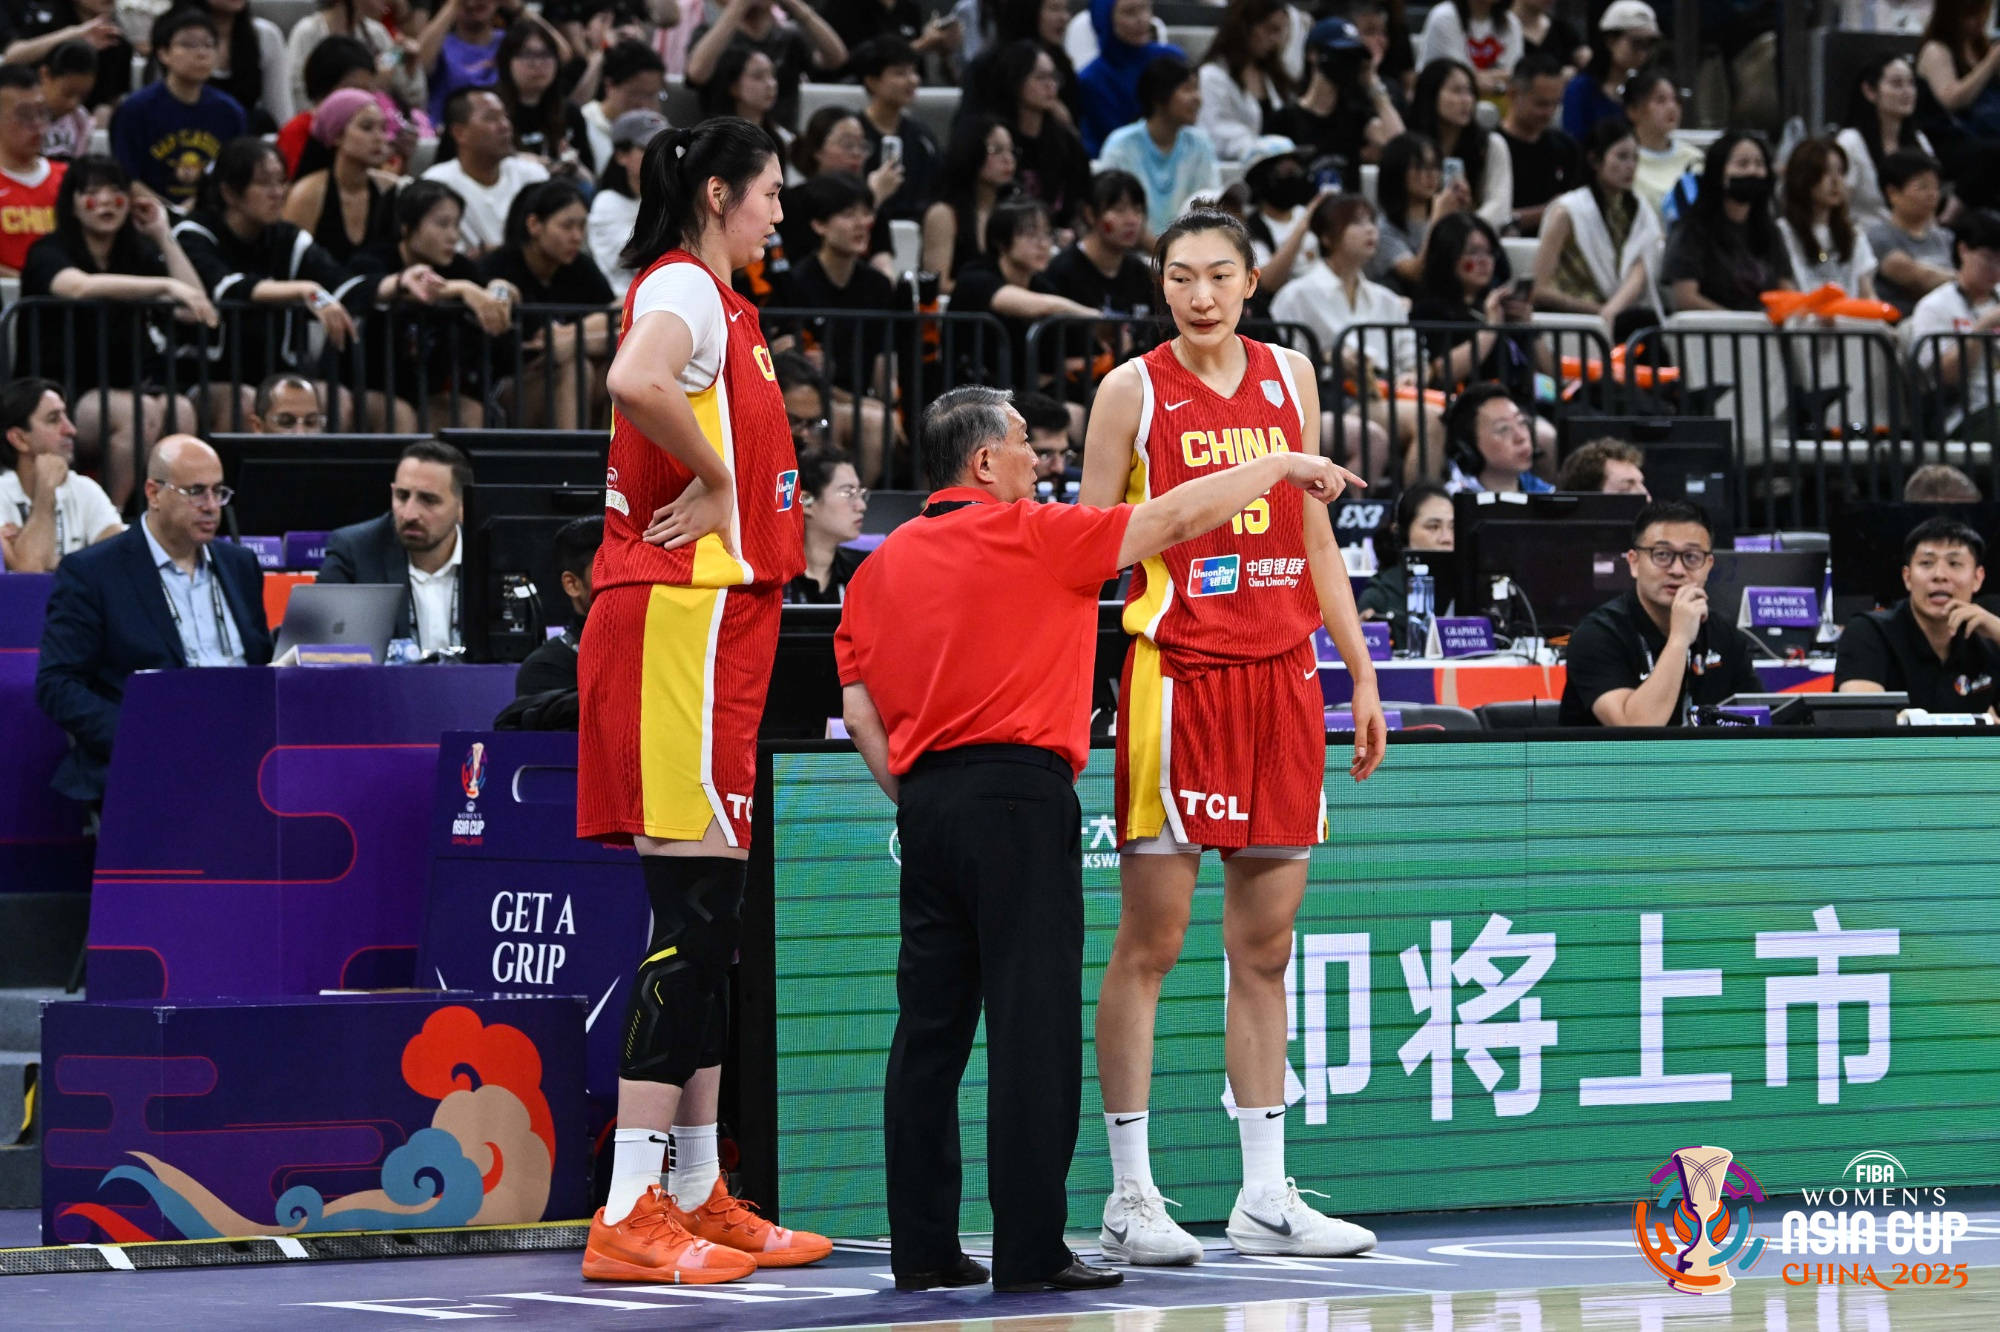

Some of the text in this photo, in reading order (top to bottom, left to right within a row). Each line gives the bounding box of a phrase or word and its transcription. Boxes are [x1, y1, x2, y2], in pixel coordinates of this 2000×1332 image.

[1181, 427, 1290, 467] CHINA
[1193, 566, 1235, 579] UnionPay
[1246, 558, 1306, 577] 中国银联
[1248, 576, 1299, 588] China UnionPay
[1179, 789, 1249, 821] TCL
[452, 819, 485, 835] ASIA CUP
[491, 891, 576, 934] GET A
[492, 941, 566, 984] GRIP
